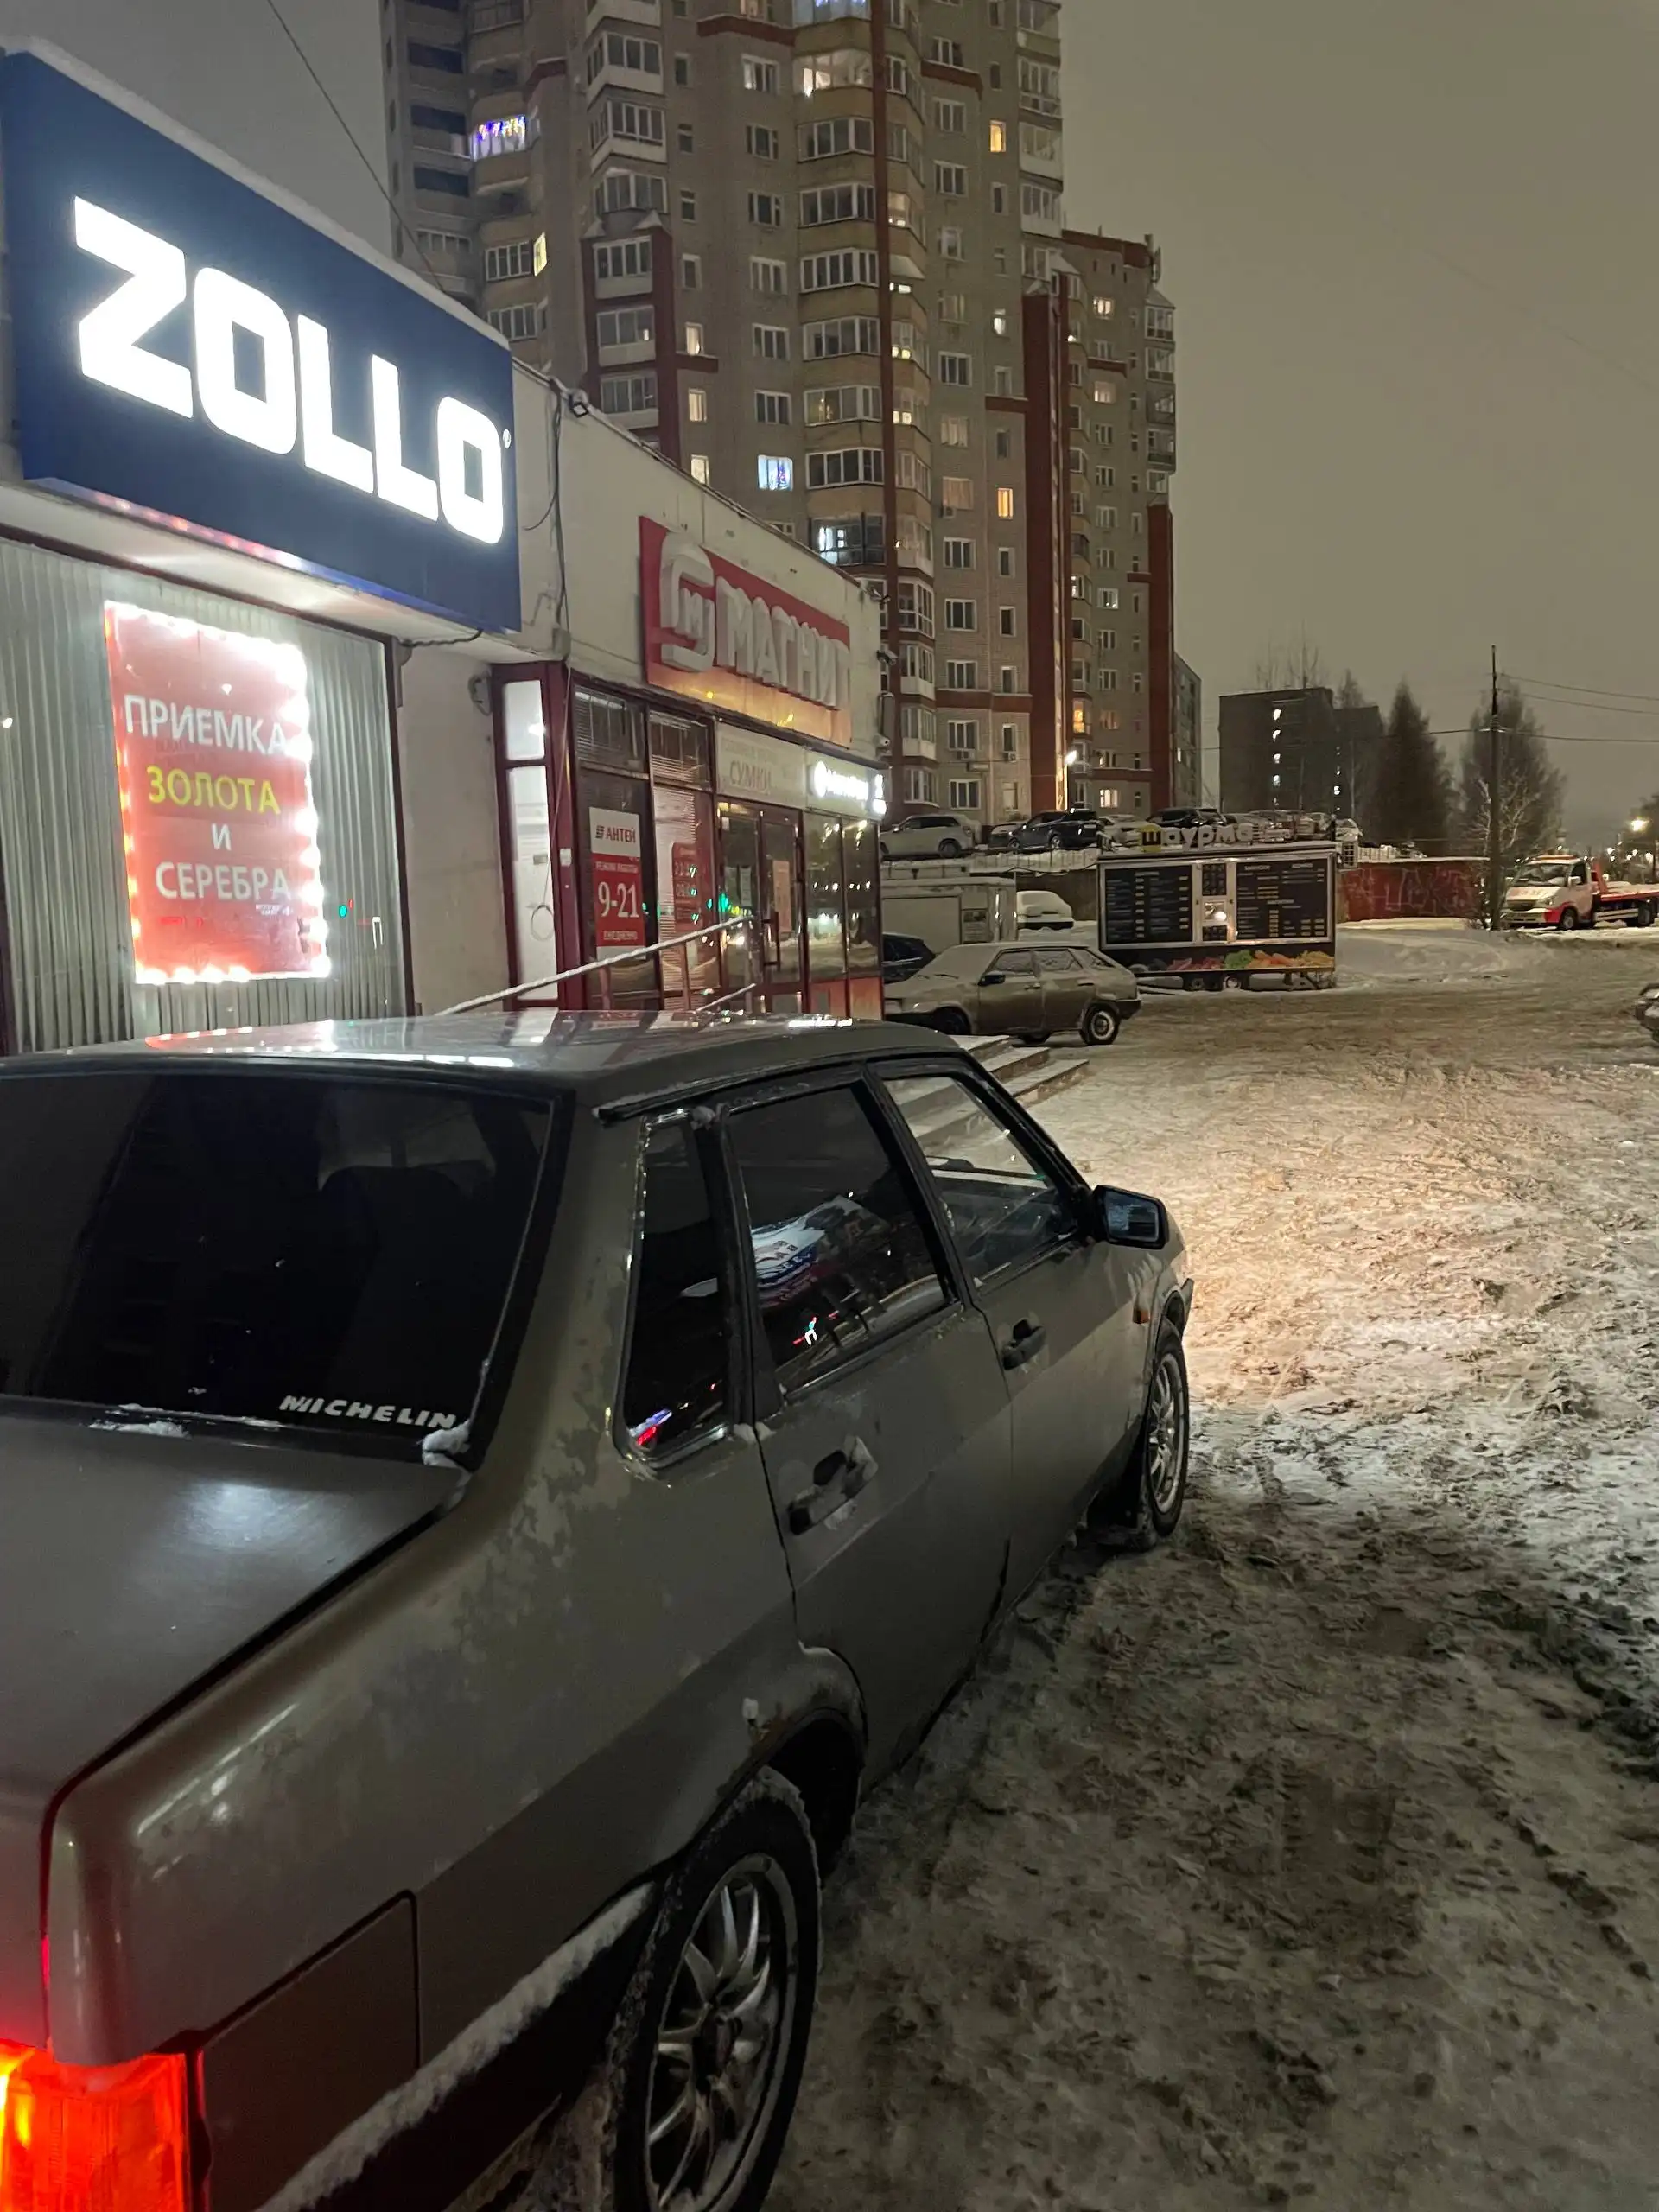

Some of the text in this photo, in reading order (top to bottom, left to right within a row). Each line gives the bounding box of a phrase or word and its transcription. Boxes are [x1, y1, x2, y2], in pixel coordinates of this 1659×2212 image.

[74, 196, 503, 544] ZOLLO
[716, 576, 851, 709] МАГНИТ
[124, 694, 289, 754] ПРИЕМКА
[146, 765, 282, 815] ЗОЛОТА
[729, 760, 772, 791] СУМКИ
[606, 827, 637, 844] АНТЕЙ
[155, 861, 292, 901] СЕРЕБРА
[598, 881, 640, 918] 9-21
[279, 1395, 457, 1429] MICHELIN
